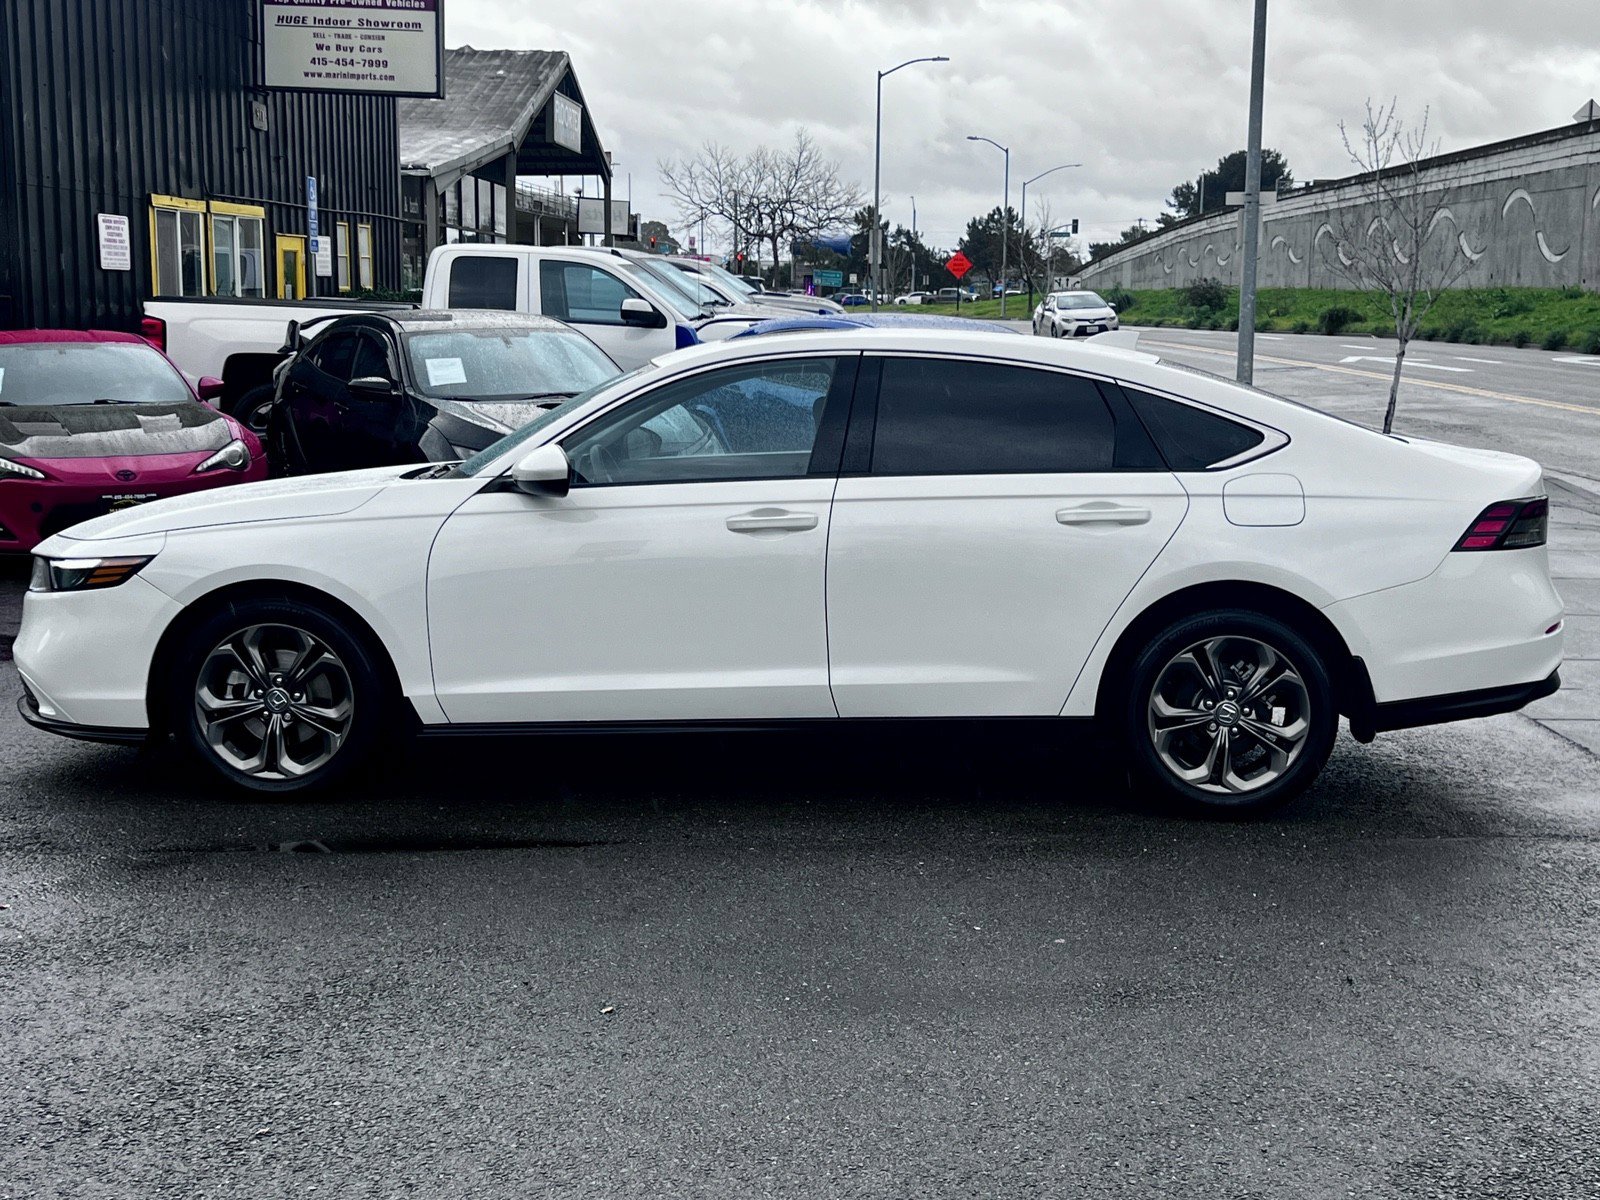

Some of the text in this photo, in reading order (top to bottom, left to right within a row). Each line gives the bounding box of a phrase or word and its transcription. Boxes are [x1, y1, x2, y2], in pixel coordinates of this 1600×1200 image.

[386, 0, 426, 8] Vehicles
[277, 15, 422, 29] HUGE Indoor Showroom
[315, 43, 383, 53] We Buy Cars
[310, 57, 389, 68] 415-454-7999
